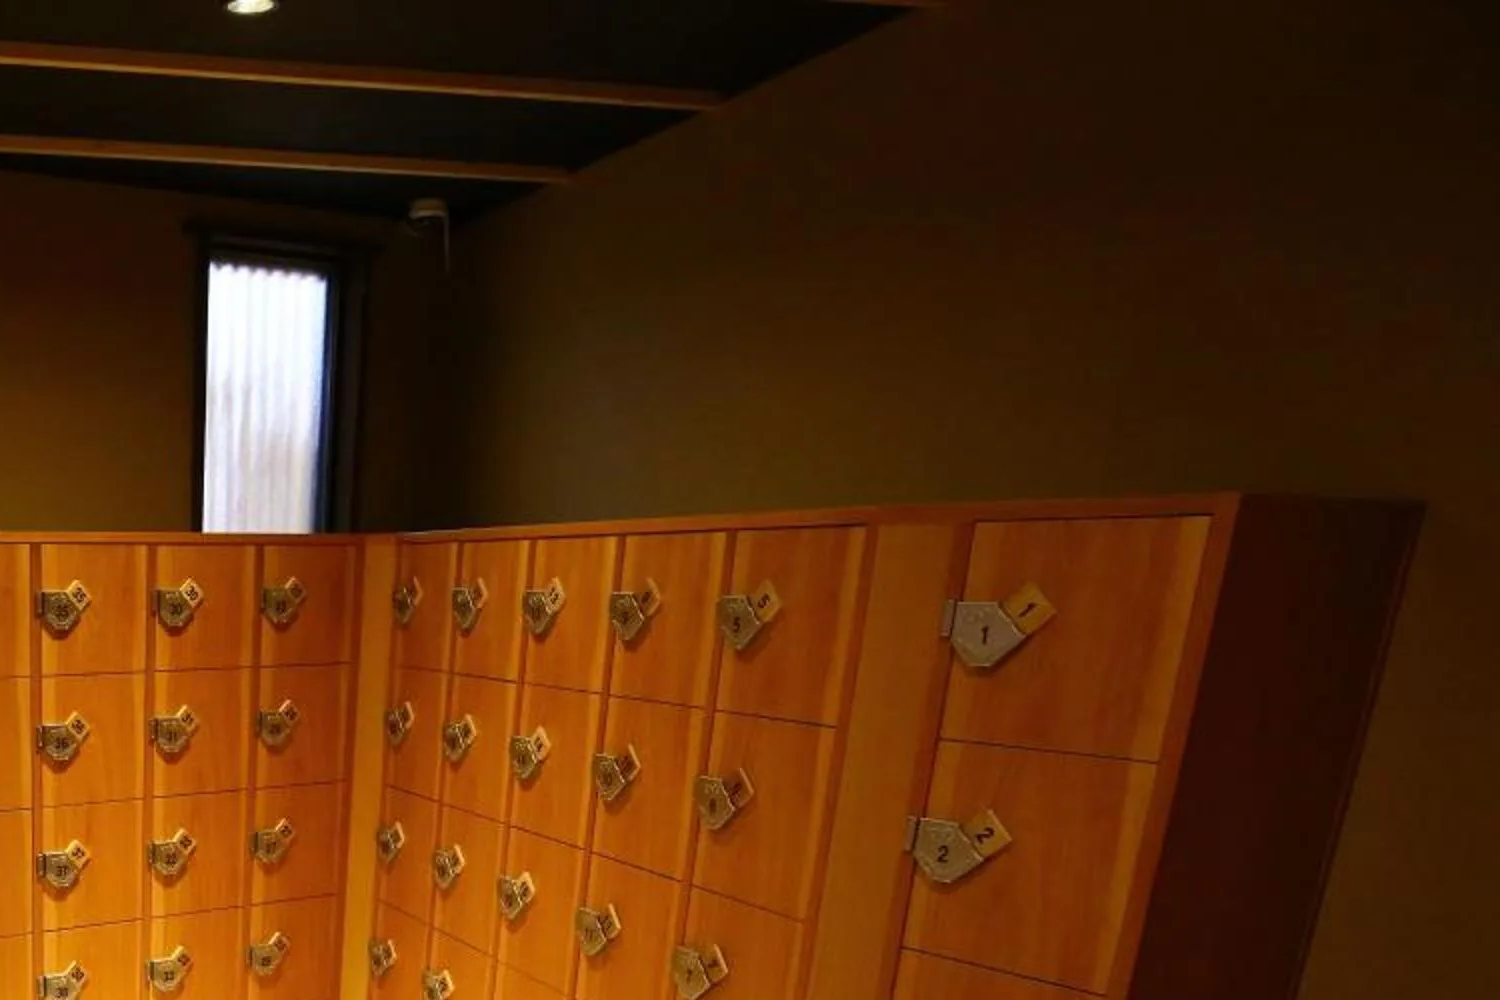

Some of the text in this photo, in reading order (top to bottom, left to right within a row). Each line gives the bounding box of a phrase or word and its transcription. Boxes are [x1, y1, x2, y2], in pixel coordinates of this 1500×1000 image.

[1018, 602, 1036, 618] 1
[733, 617, 740, 633] 5
[981, 625, 989, 645] 1
[975, 827, 995, 844] 2
[937, 845, 949, 863] 2
